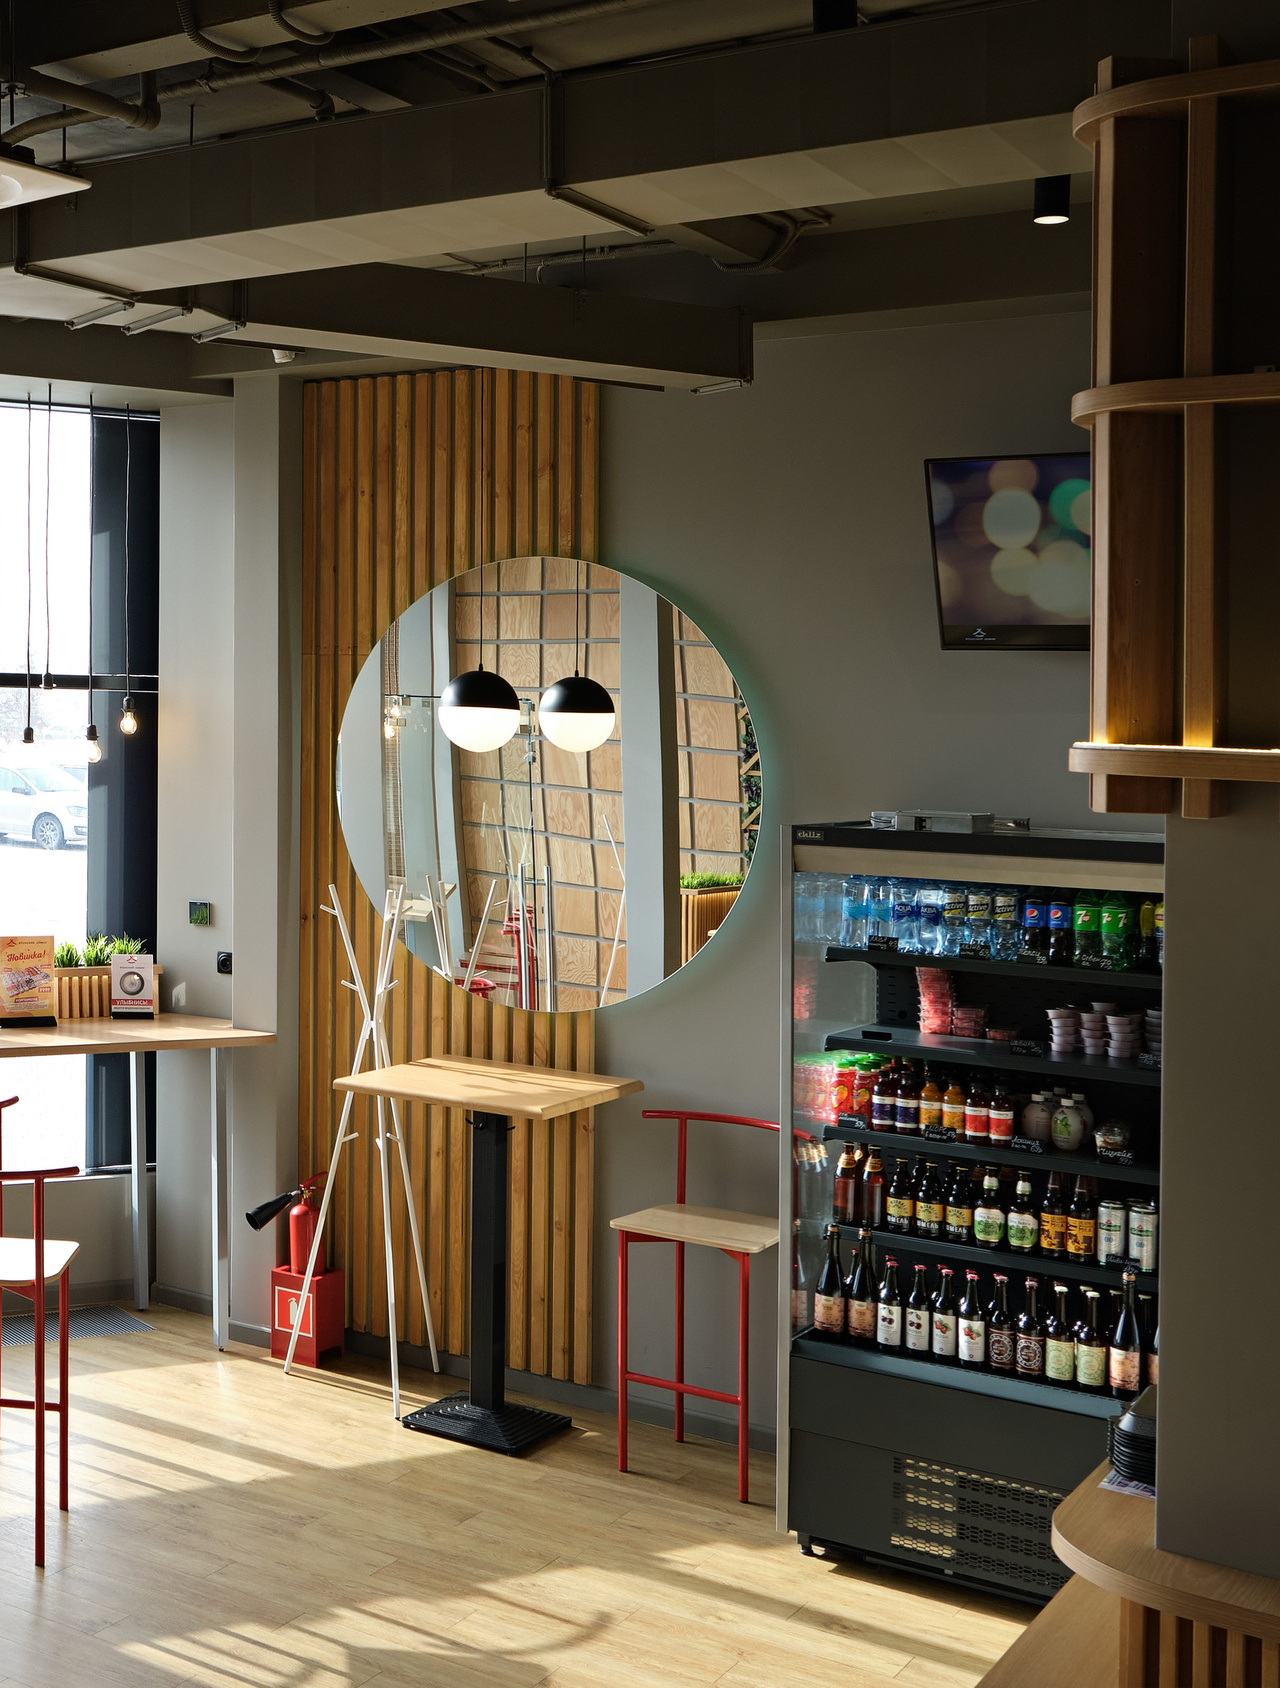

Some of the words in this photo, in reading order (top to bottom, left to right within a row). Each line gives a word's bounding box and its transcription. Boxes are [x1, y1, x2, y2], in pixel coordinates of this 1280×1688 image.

[920, 906, 937, 914] АКВА
[944, 902, 965, 910] Active
[968, 904, 988, 912] Active
[994, 906, 1015, 914] Active
[6, 949, 46, 962] Новинка!
